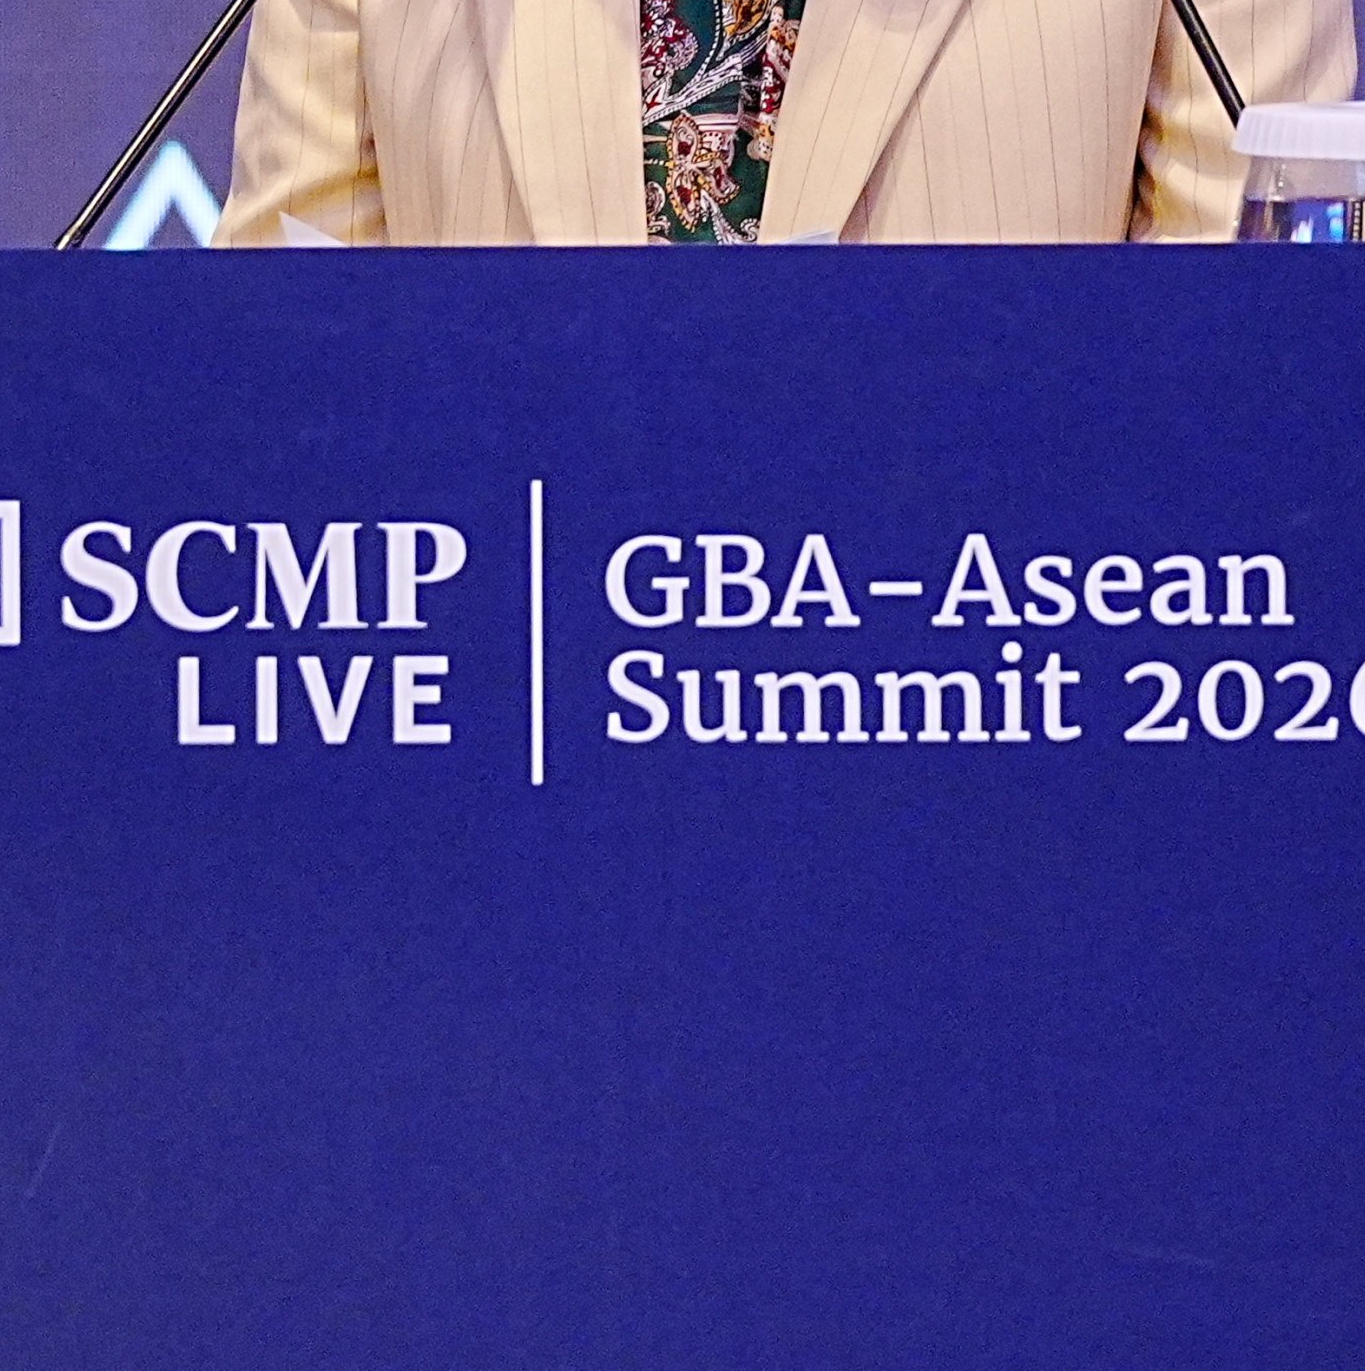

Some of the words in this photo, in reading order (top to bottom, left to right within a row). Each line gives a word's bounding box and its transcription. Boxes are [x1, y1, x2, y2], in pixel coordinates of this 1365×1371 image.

[62, 522, 466, 631] SCMP
[179, 656, 450, 744] LIVE
[608, 642, 1081, 742] Summit
